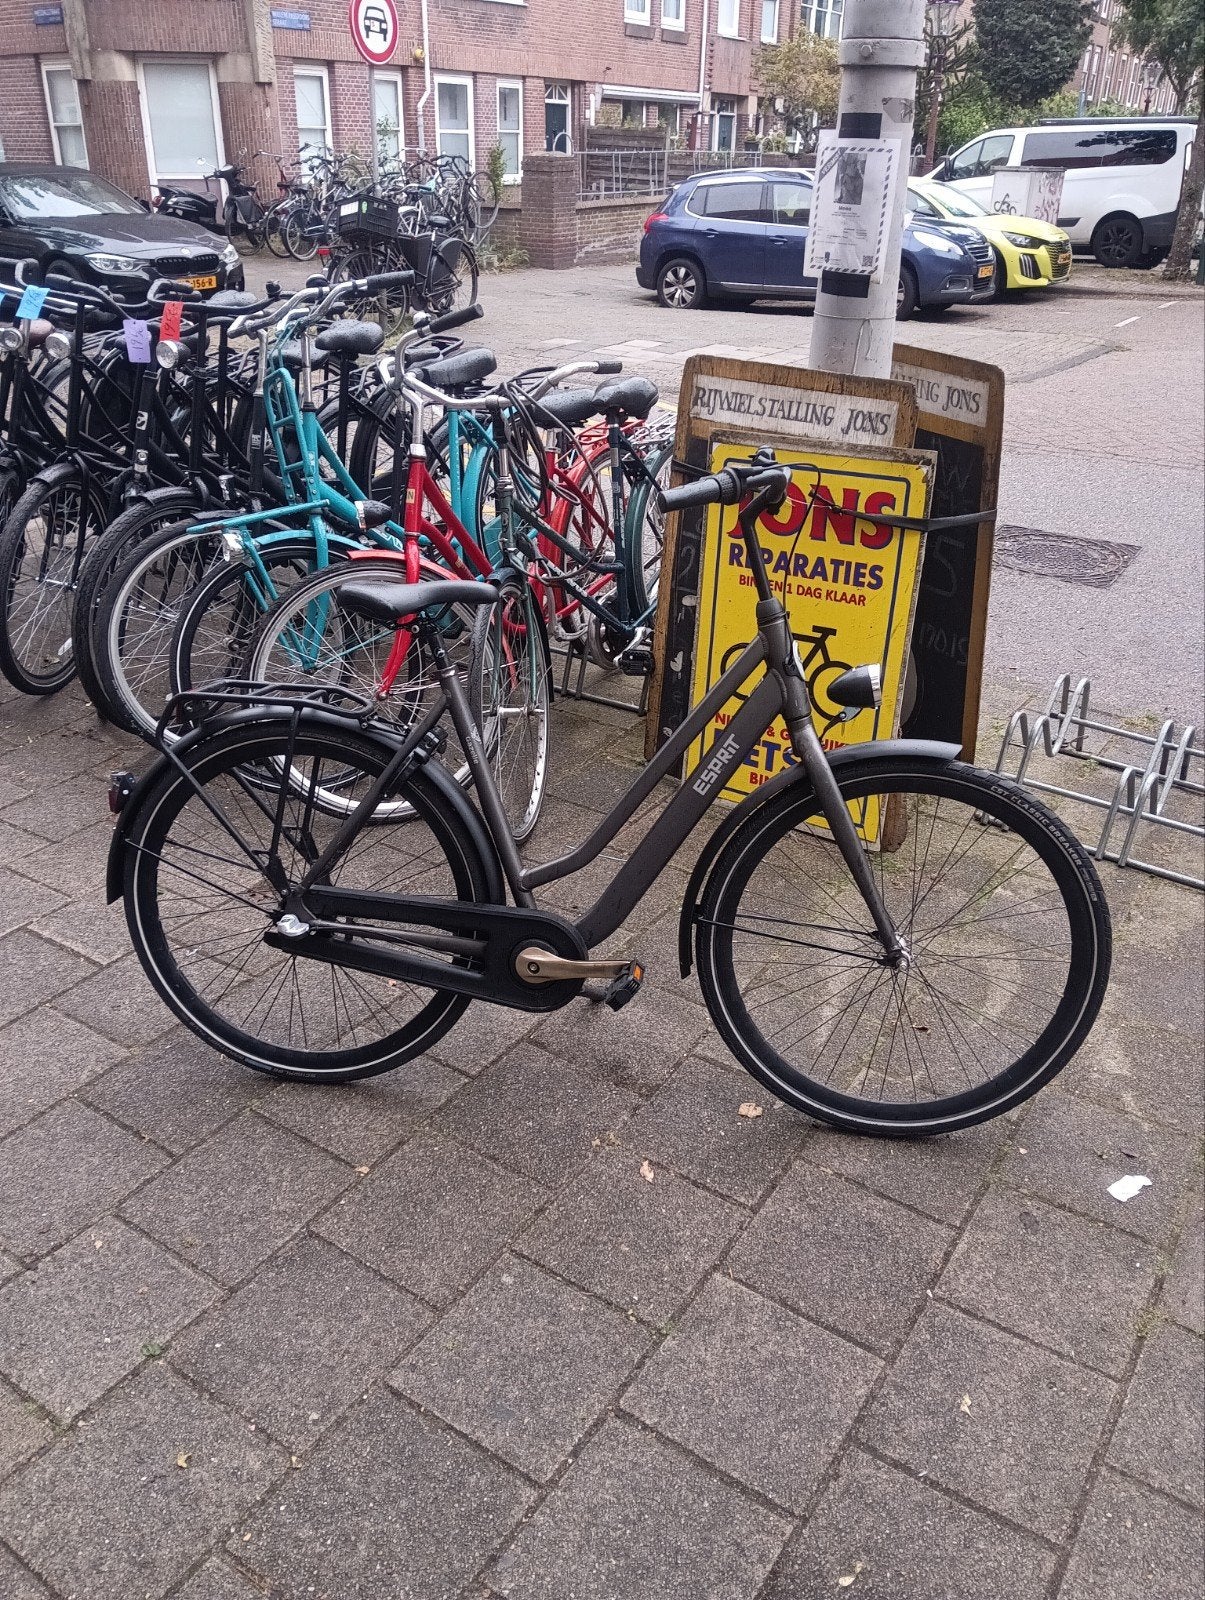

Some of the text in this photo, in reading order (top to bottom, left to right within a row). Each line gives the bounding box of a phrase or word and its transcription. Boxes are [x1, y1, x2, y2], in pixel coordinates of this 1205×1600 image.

[692, 386, 891, 436] RIJWIELSTALLING JONS
[942, 386, 982, 413] JONS
[739, 574, 867, 607] BINEN 1 DAG KLAAR
[692, 733, 741, 796] ESPRIT
[990, 785, 1083, 867] CST CLASSIC BREAKER
